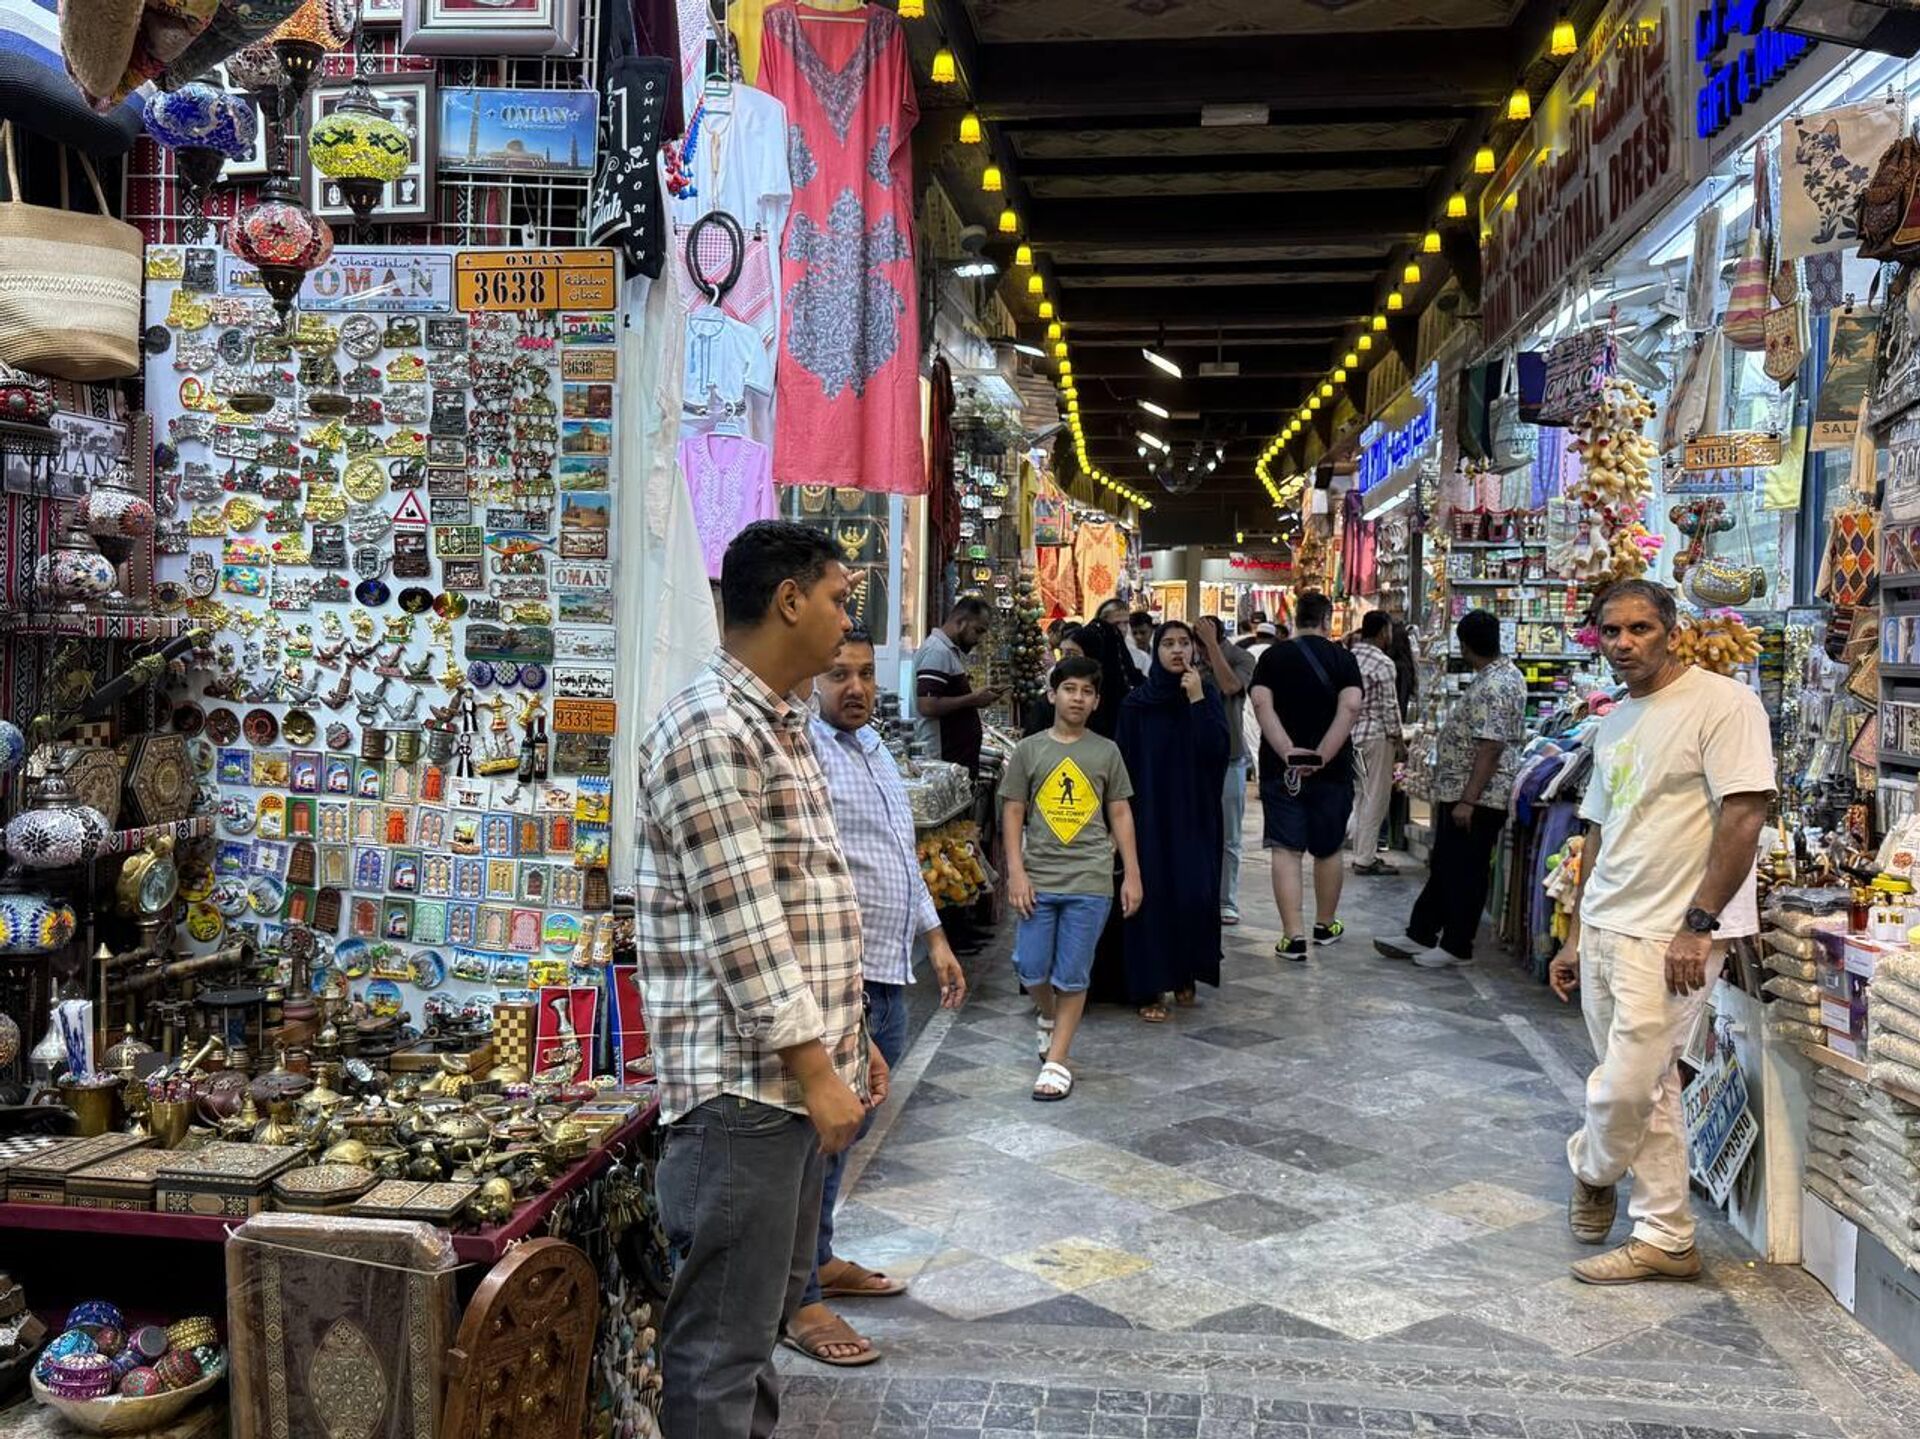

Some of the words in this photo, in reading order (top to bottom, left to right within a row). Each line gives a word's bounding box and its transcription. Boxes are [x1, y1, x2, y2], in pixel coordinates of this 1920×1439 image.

[501, 105, 569, 122] OMAN
[1511, 171, 1604, 326] TRADITIONAL
[1609, 108, 1670, 227] DRESS
[505, 254, 564, 266] OMAN
[313, 267, 436, 298] OMAN
[474, 270, 545, 305] 3638
[564, 273, 607, 287] سلطنة
[569, 288, 602, 301] عمان
[569, 323, 613, 334] OMAN
[563, 359, 593, 376] 3638
[1695, 445, 1738, 465] 3638
[555, 569, 607, 586] OMAN
[556, 710, 590, 727] 9333
